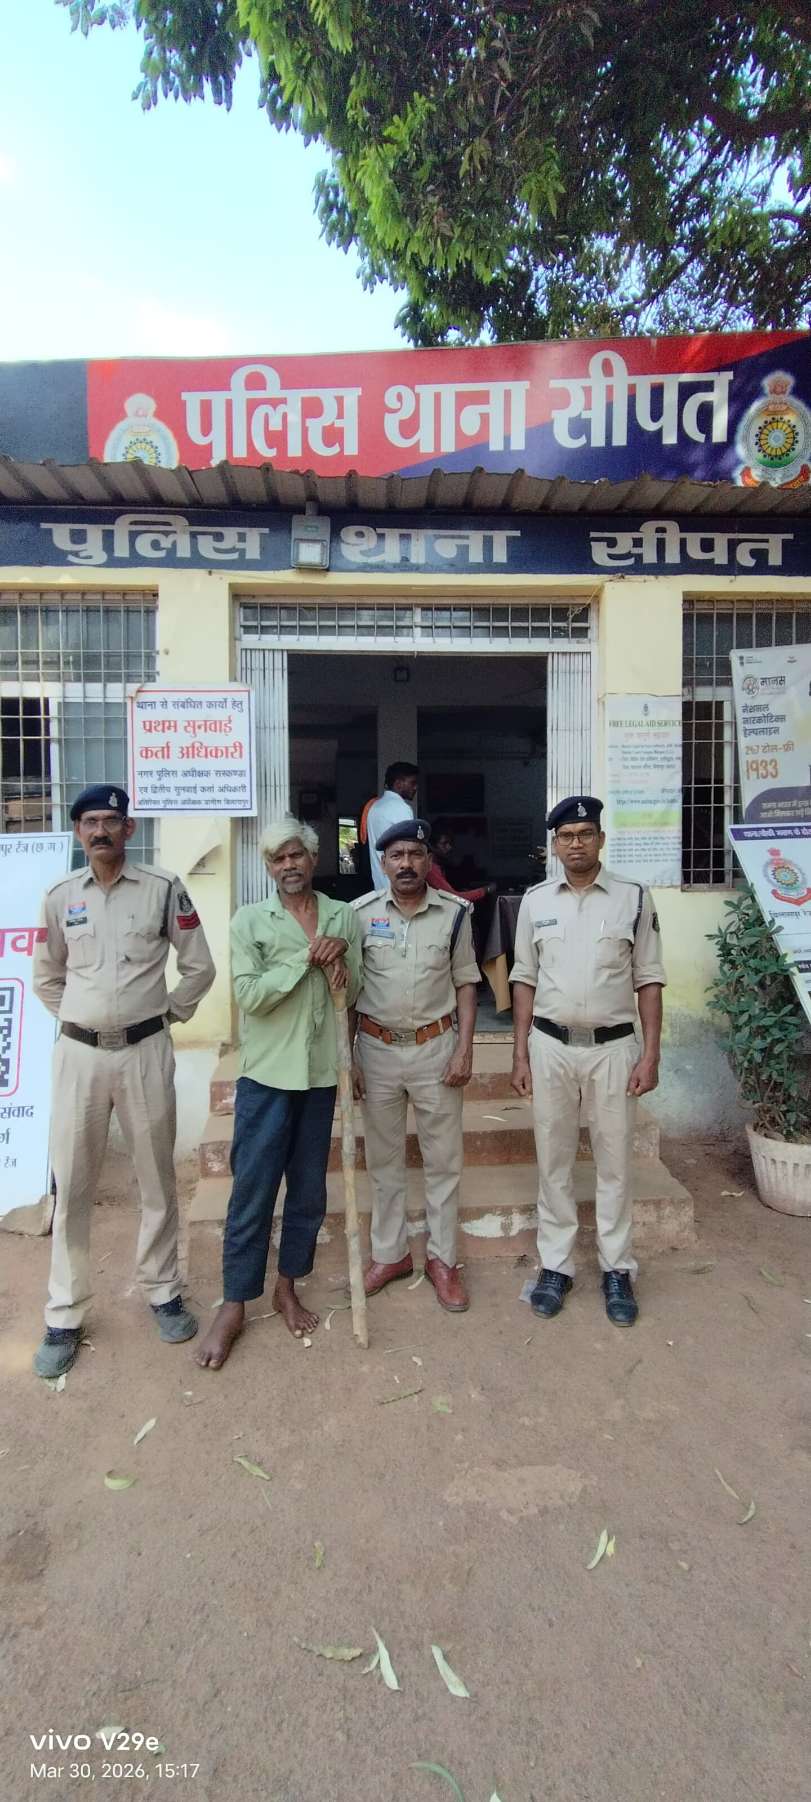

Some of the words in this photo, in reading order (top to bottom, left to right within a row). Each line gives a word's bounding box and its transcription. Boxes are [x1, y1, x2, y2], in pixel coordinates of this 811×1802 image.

[384, 381, 530, 453] थाना
[549, 350, 733, 449] सीपत
[40, 513, 269, 566] पुलिस
[339, 525, 521, 564] थाना
[589, 520, 794, 567] सीपत
[137, 700, 156, 710] थाना
[160, 698, 168, 710] से
[232, 698, 244, 713] हेतु
[142, 719, 178, 734] प्रथम
[184, 715, 232, 737] सुनवाई
[140, 741, 171, 759] कर्ता
[178, 741, 244, 759] अधिकारी
[137, 769, 153, 778] नगर
[157, 768, 178, 781] पुलिस
[746, 758, 779, 780] 1933
